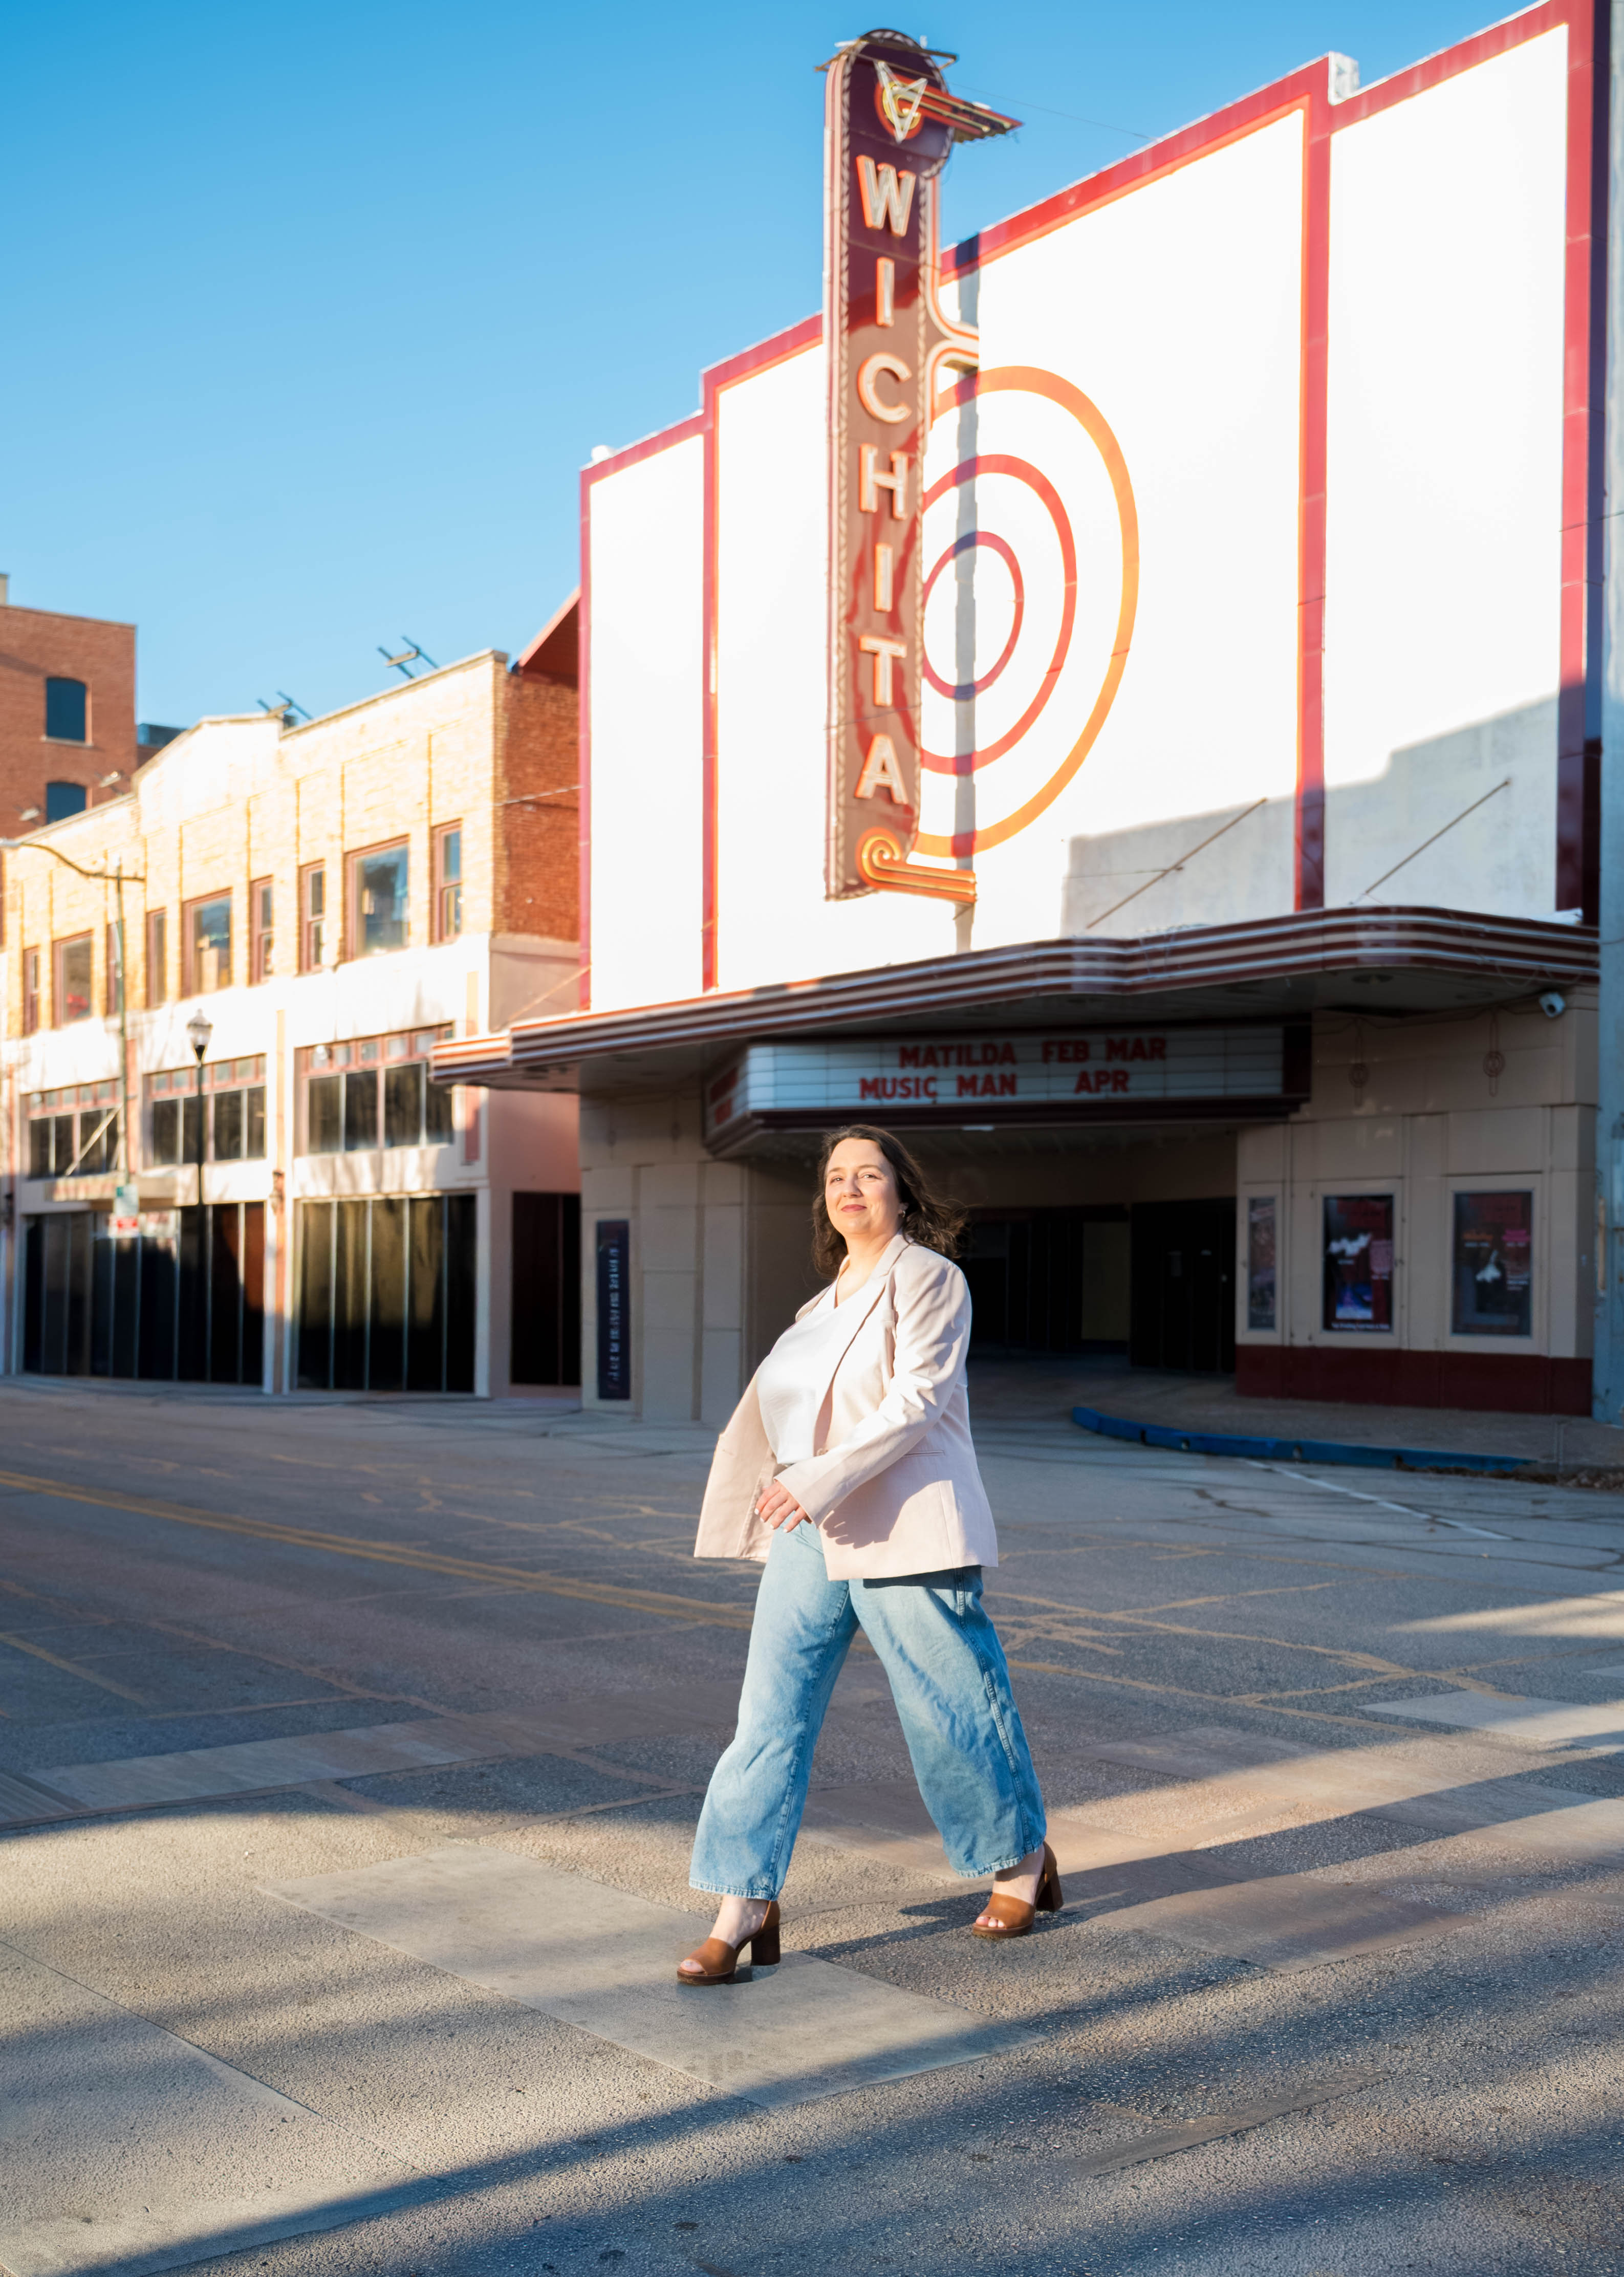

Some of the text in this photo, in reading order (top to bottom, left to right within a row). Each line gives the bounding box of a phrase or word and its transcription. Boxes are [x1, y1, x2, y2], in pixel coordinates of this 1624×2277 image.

[855, 155, 916, 805] WICHITA
[899, 1037, 1165, 1068] MATILDA FEB MAR
[860, 1070, 1129, 1099] MUSIC MAN APR
